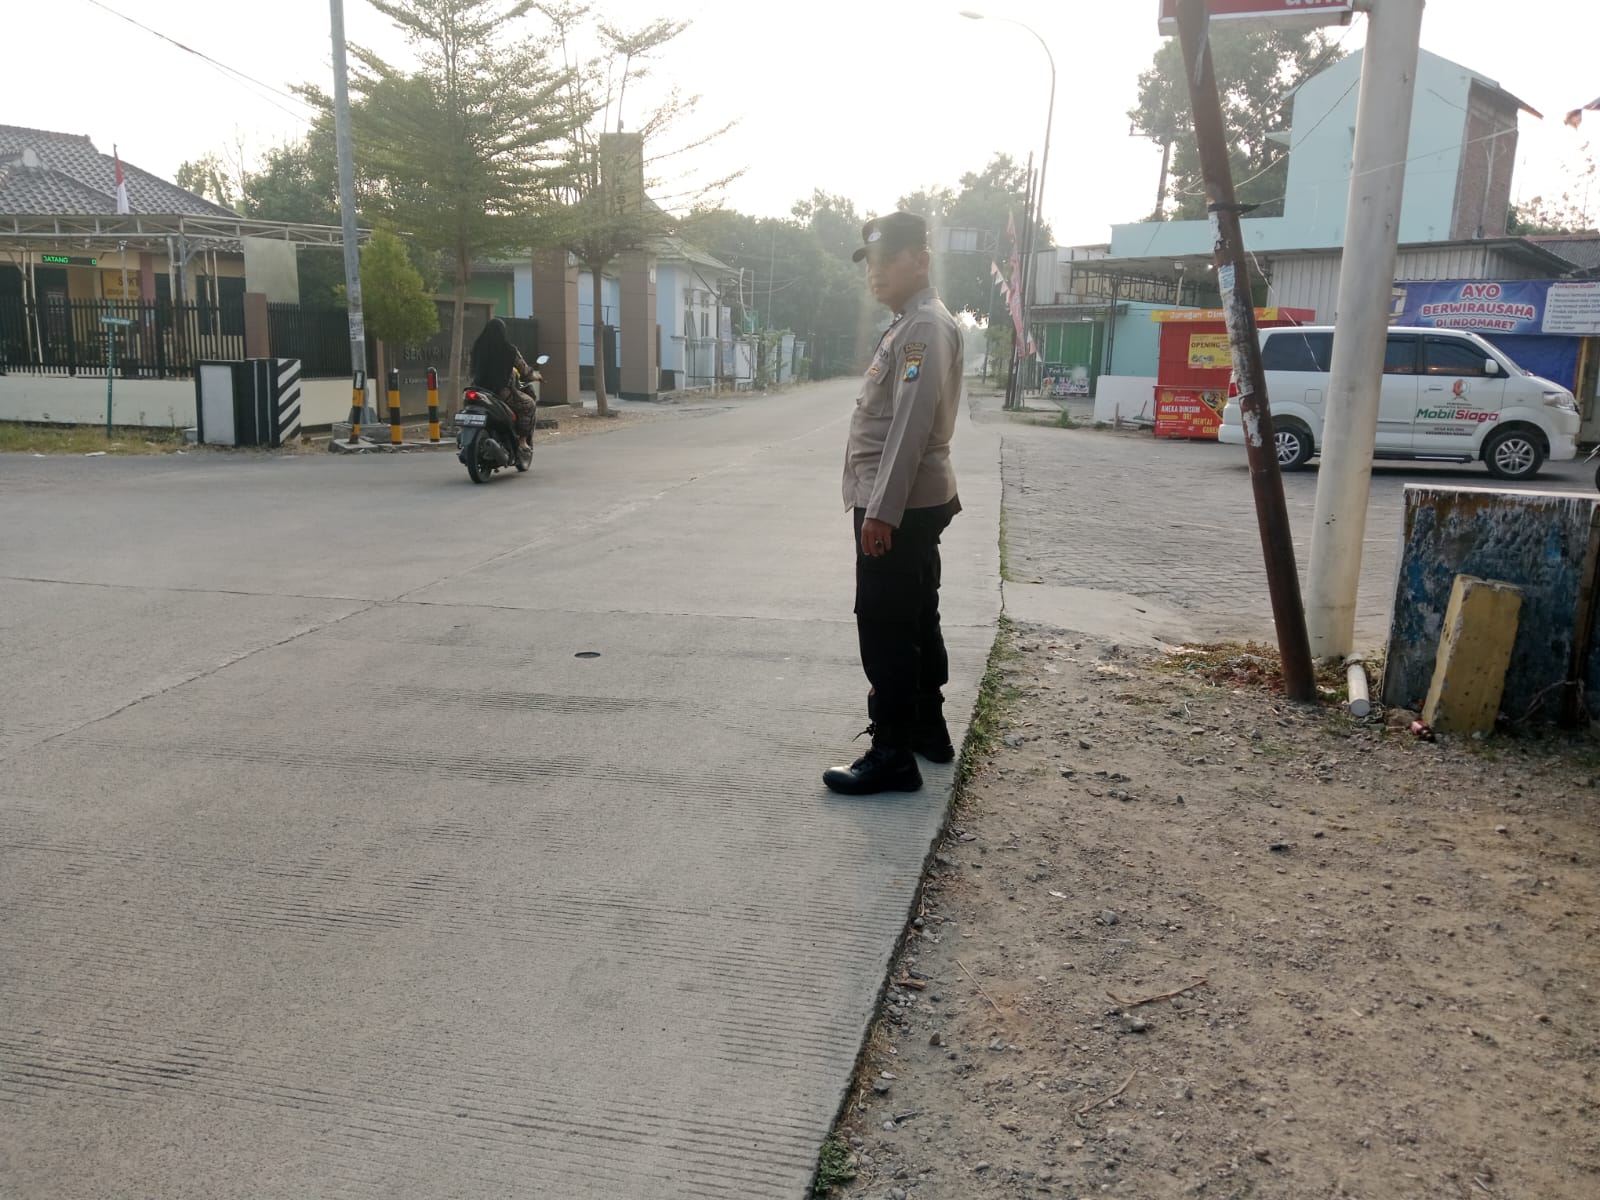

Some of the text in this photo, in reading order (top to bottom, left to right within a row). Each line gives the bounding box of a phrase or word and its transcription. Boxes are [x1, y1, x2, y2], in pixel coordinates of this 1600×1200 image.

[1461, 283, 1501, 299] AYO
[1422, 302, 1535, 318] BERWIRAUSAHA
[1435, 318, 1516, 330] DI INDOMARET
[1416, 408, 1499, 423] MobilSiaga
